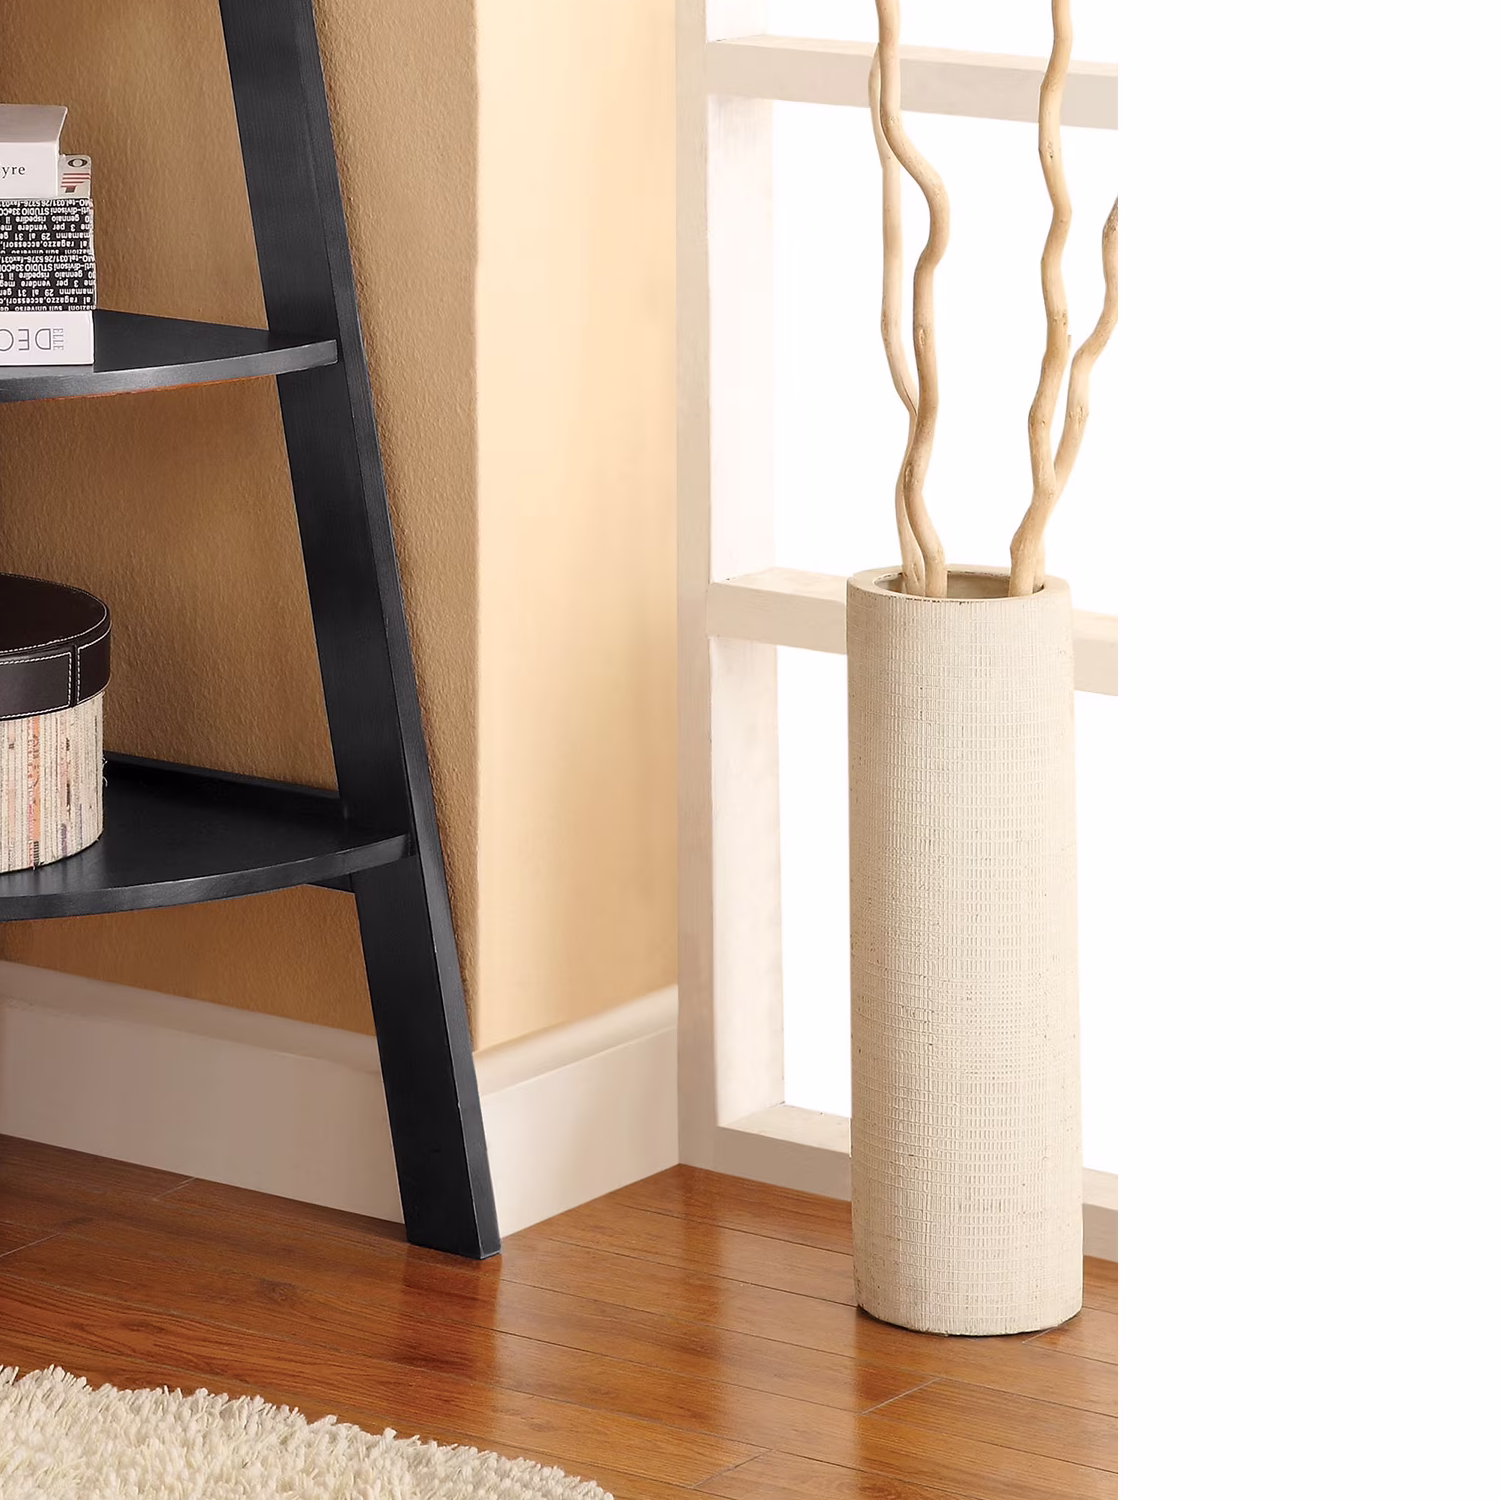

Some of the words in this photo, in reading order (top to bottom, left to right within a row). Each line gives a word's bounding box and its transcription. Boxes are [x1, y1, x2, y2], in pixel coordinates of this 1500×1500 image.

[51, 214, 80, 223] gennaio
[70, 224, 75, 232] 3
[29, 233, 36, 241] al
[25, 263, 53, 271] STUDIO
[54, 270, 83, 280] gennaio
[20, 280, 51, 288] vendere
[56, 279, 68, 287] per
[18, 289, 27, 297] 31
[32, 289, 39, 297] al
[44, 289, 54, 297] 29
[83, 297, 91, 305] al
[53, 328, 64, 350] ELLE
